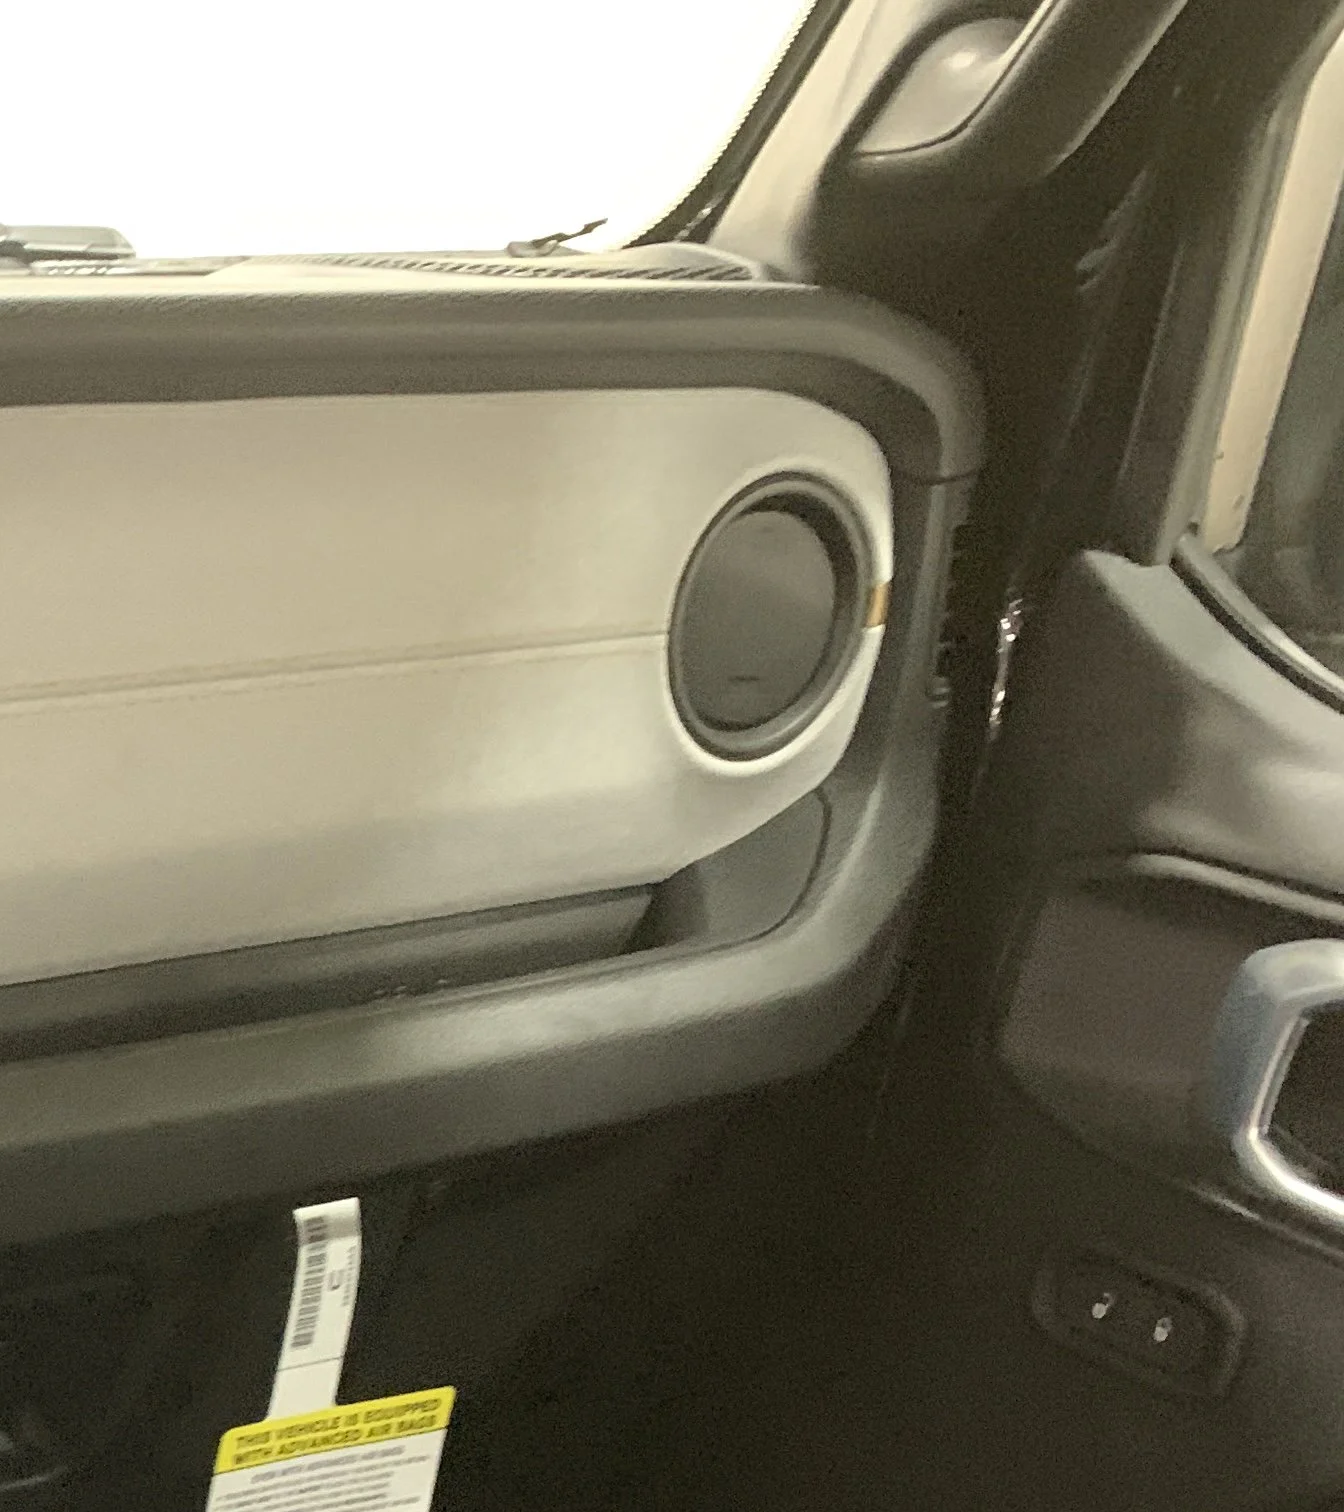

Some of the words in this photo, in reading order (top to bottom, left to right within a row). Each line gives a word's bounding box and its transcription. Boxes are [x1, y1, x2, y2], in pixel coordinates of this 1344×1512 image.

[233, 1447, 274, 1466] WITH
[276, 1427, 363, 1456] ADVANCED
[366, 1422, 393, 1440] AIR
[397, 1413, 439, 1433] BAGS
[235, 1430, 271, 1450] THIS
[275, 1415, 342, 1442] VEHICLE
[344, 1411, 359, 1428] IS
[363, 1398, 443, 1425] EQUIPPED
